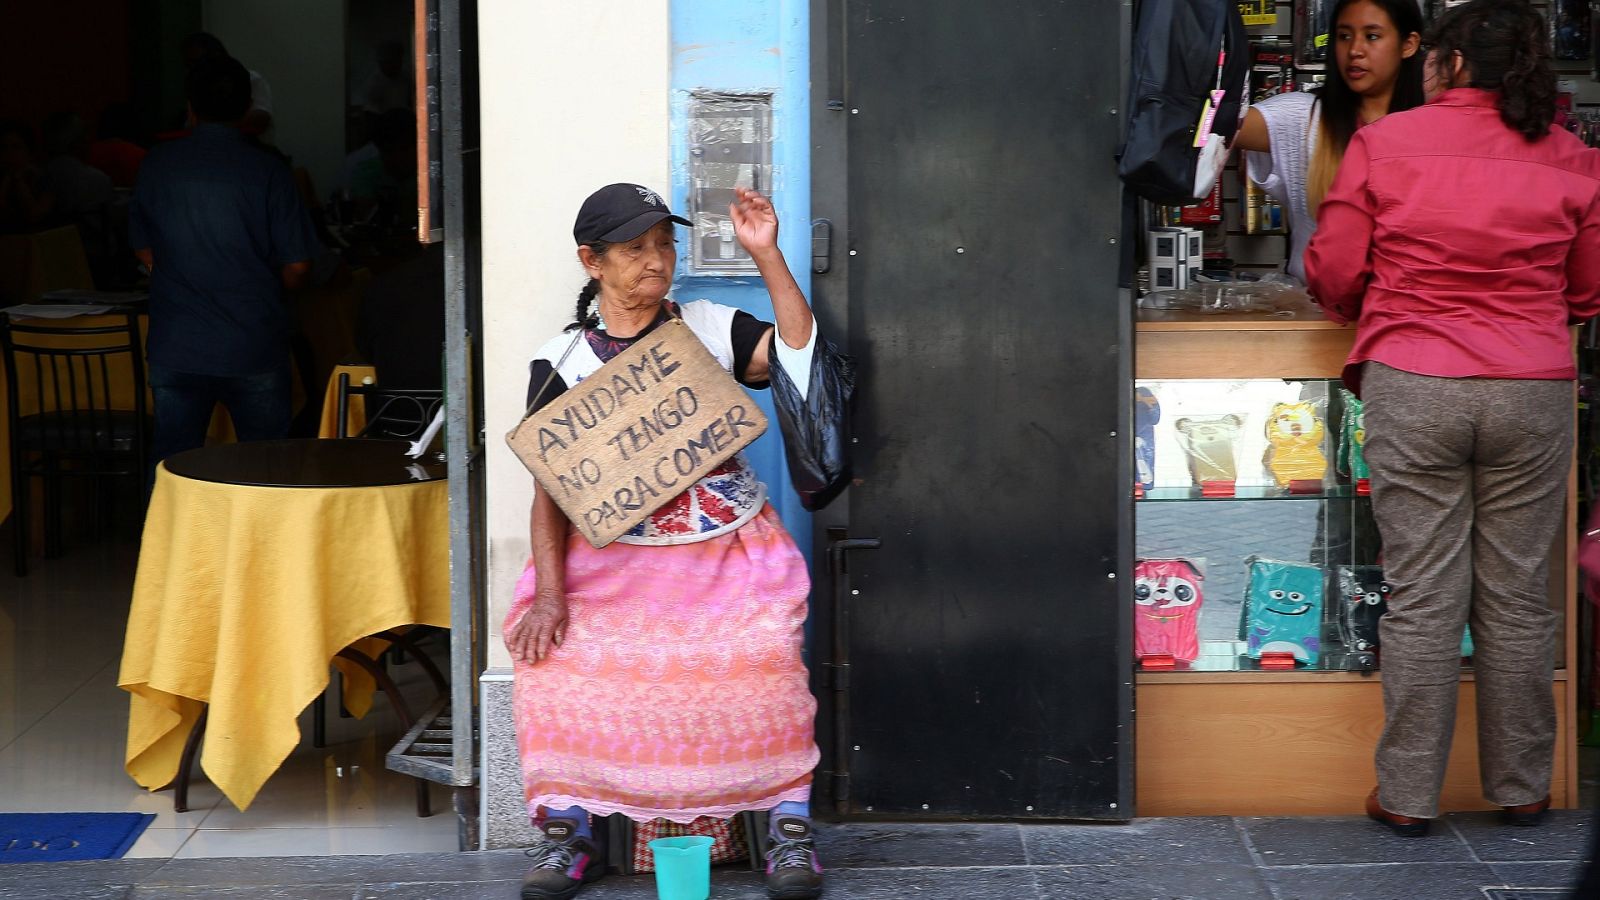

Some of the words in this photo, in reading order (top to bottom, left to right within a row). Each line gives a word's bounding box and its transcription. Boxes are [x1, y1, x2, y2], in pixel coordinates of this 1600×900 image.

[538, 341, 683, 461] AYUDAME
[557, 457, 601, 495] NO
[607, 386, 699, 461] TENGO
